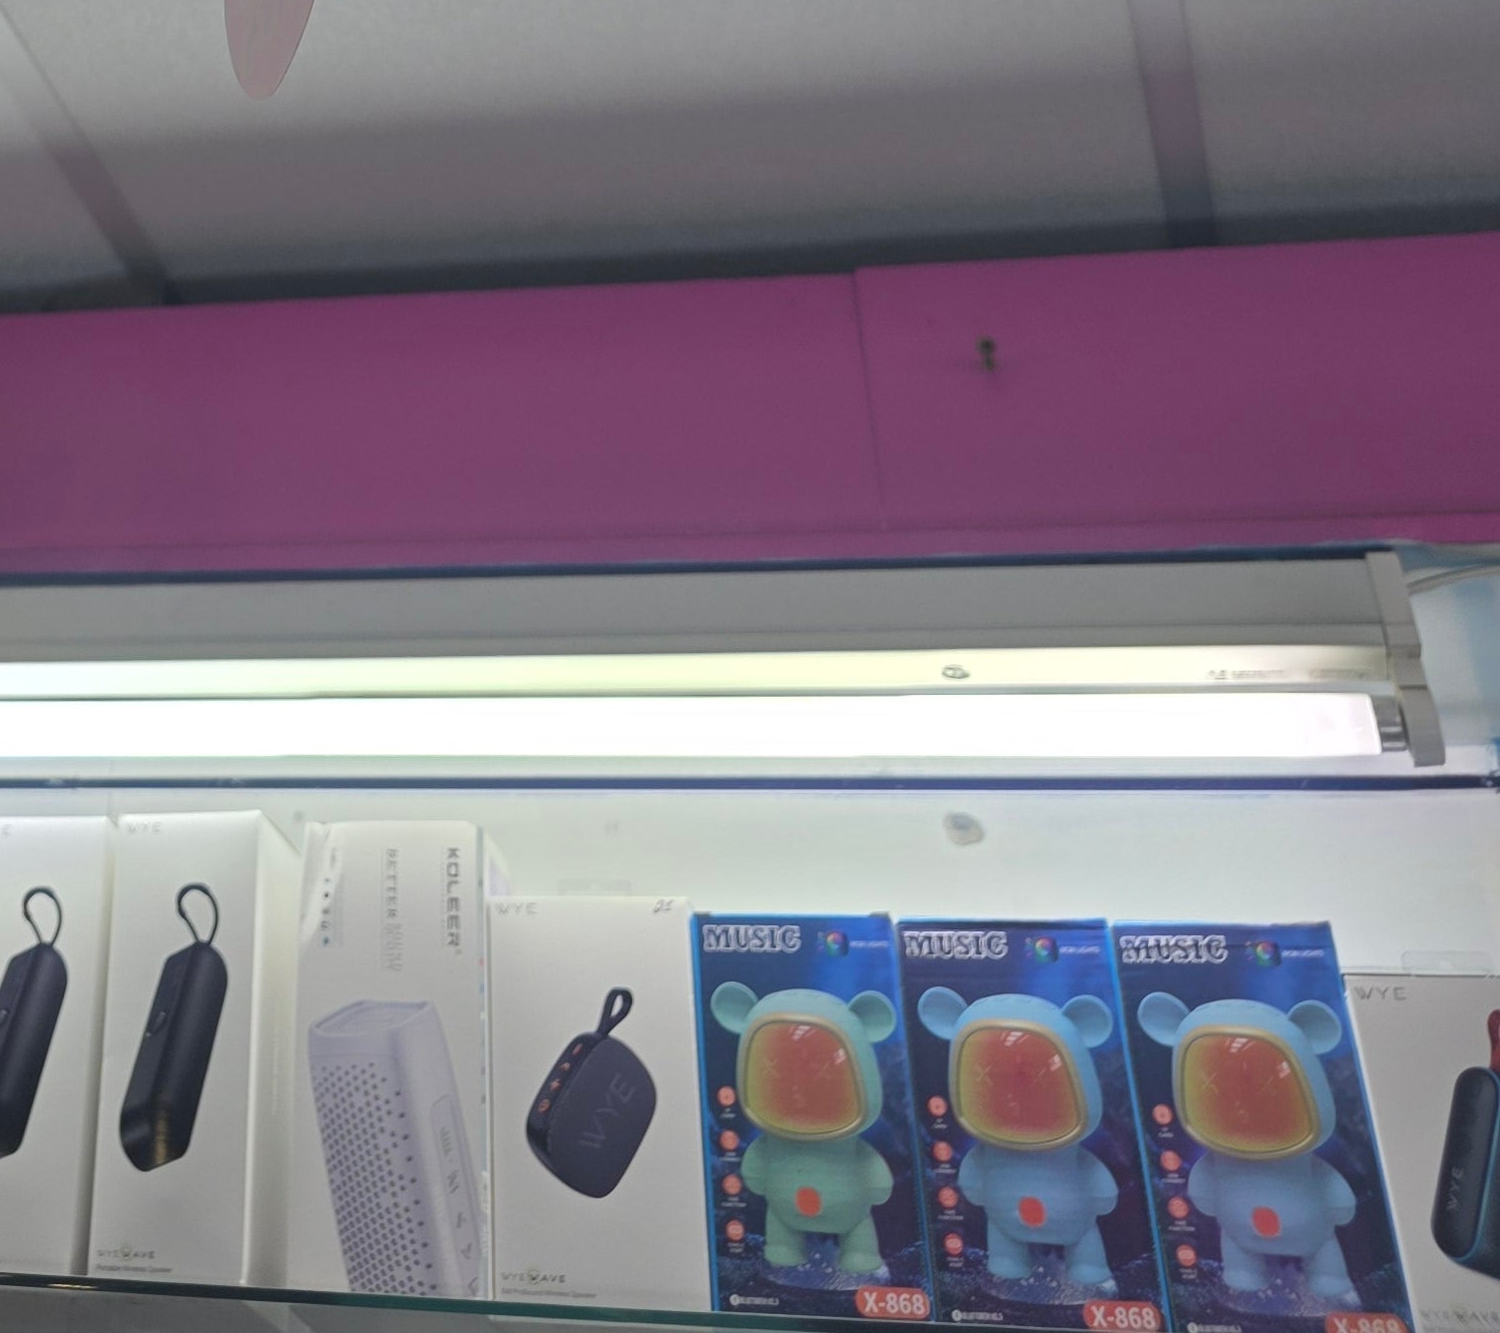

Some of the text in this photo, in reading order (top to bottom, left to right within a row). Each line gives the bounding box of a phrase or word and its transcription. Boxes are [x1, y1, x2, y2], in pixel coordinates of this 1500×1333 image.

[446, 847, 461, 947] KOLEER
[495, 902, 539, 916] WYE
[703, 925, 801, 953] MUSIC
[904, 931, 1009, 959] MUSIC
[1120, 935, 1228, 964] MUSIC
[1355, 986, 1407, 1000] WYE
[863, 1292, 926, 1315] X-868
[1091, 1305, 1157, 1329] X-868
[1333, 1318, 1400, 1333] X-868
